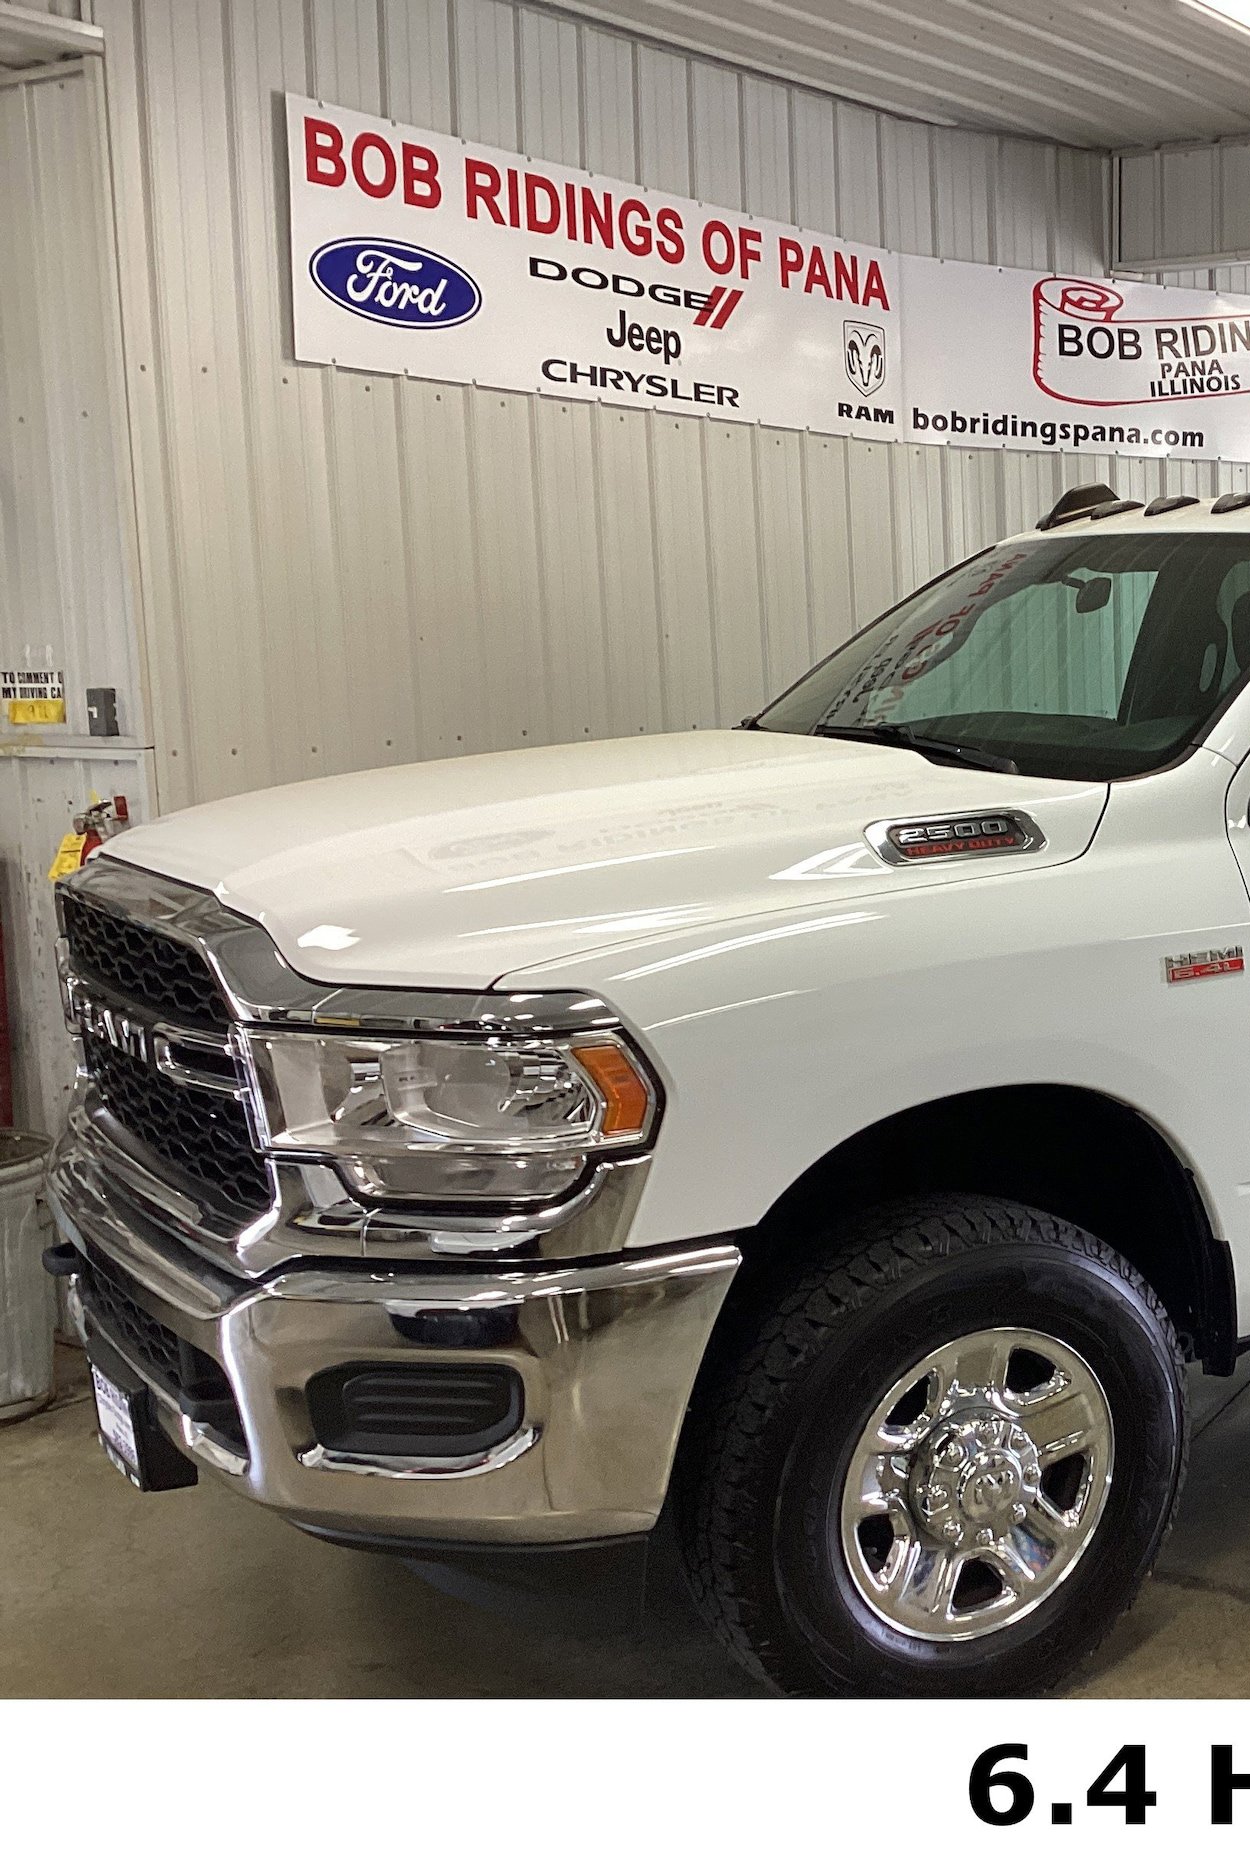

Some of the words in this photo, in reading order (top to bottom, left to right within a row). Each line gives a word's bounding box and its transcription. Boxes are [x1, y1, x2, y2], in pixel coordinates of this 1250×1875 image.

[304, 116, 442, 209] BOB
[464, 157, 686, 264] RIDINGS
[701, 219, 762, 280] OF
[779, 236, 891, 311] PANA
[346, 249, 448, 317] Ford
[528, 256, 714, 313] DODGE
[606, 309, 682, 365] Jeep
[1057, 324, 1142, 361] BOB
[1160, 360, 1224, 380] PANA
[541, 359, 740, 409] CHRYSLER
[1149, 375, 1241, 398] ILLINOIS
[837, 402, 894, 425] RAM
[912, 407, 1205, 449] bobridingspana.com
[1, 672, 15, 684] TO
[17, 672, 54, 684] COMMENT
[2, 687, 16, 699] MY
[20, 687, 47, 699] DRIVING
[899, 820, 1008, 844] 2500
[905, 841, 964, 855] HEAVY
[968, 837, 1014, 850] DUTY
[1164, 945, 1243, 968] HEMI
[1173, 961, 1241, 979] 6.4L
